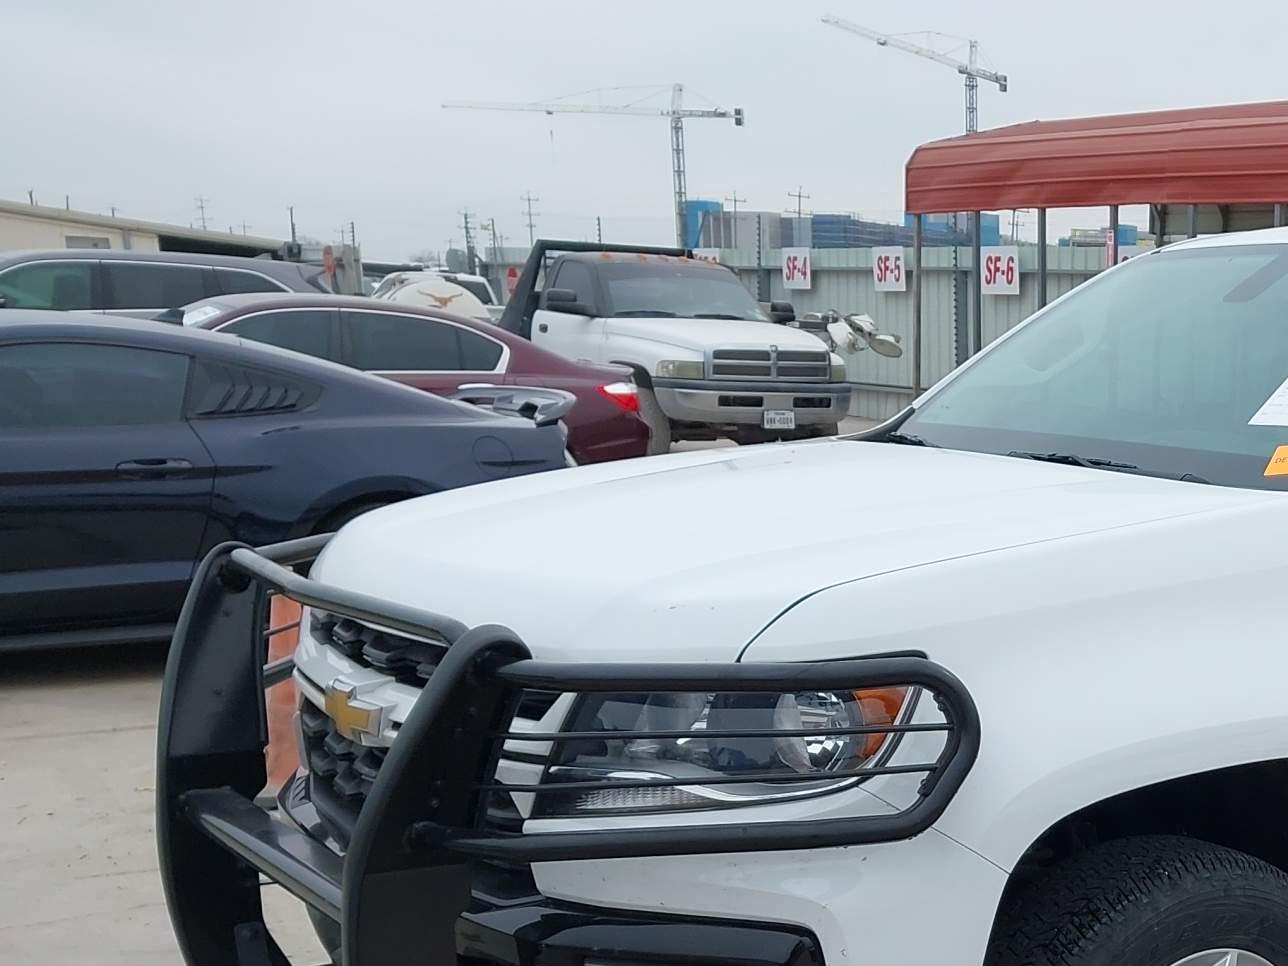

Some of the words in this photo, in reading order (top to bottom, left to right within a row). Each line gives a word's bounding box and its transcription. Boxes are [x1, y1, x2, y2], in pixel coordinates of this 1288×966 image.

[785, 255, 808, 281] SF-4
[876, 255, 901, 283] SF-5
[984, 255, 1015, 286] SF-6
